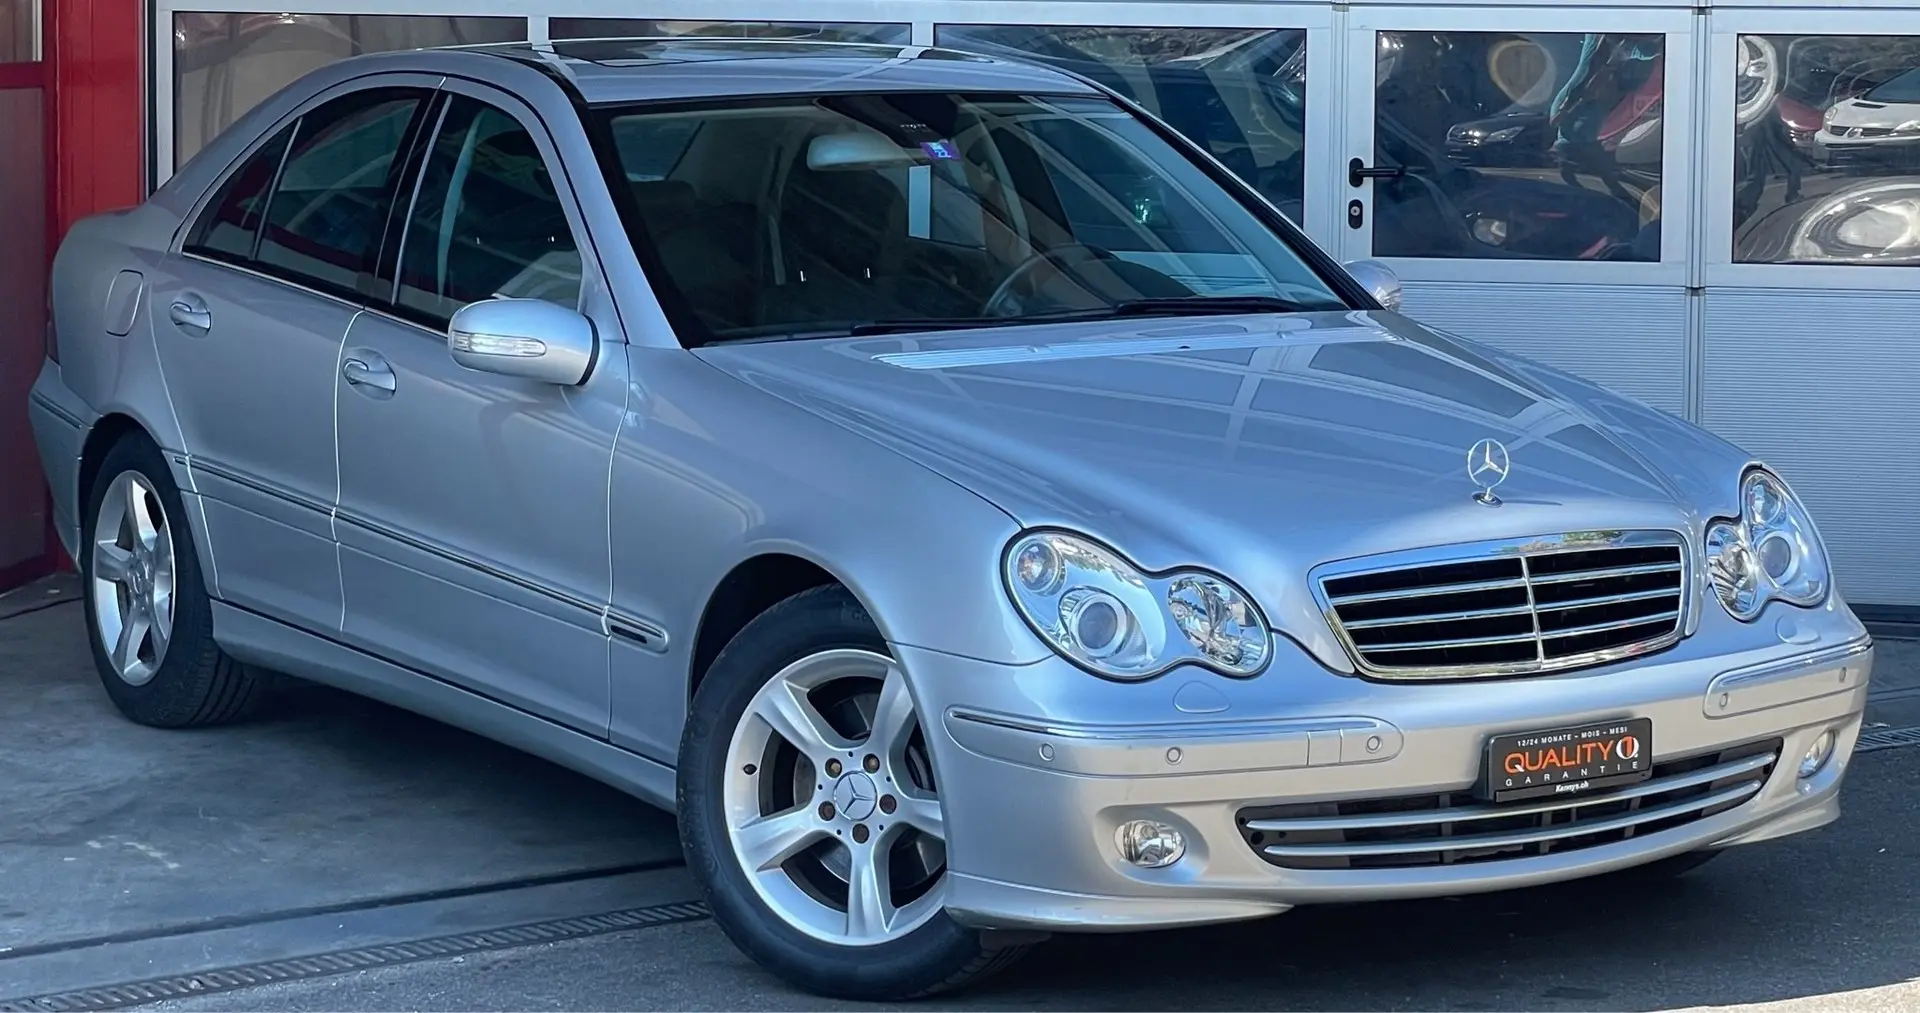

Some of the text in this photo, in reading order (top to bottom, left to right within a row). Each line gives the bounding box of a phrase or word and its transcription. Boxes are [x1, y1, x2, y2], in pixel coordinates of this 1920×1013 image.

[1517, 738, 1539, 747] 12/24
[1541, 733, 1572, 744] MONATE
[1581, 730, 1600, 739] MOIS
[1609, 726, 1628, 735] MESI
[1504, 740, 1614, 774] QUALITY
[1505, 761, 1638, 787] GARANTIE
[1555, 781, 1589, 793] Kennys.ch
